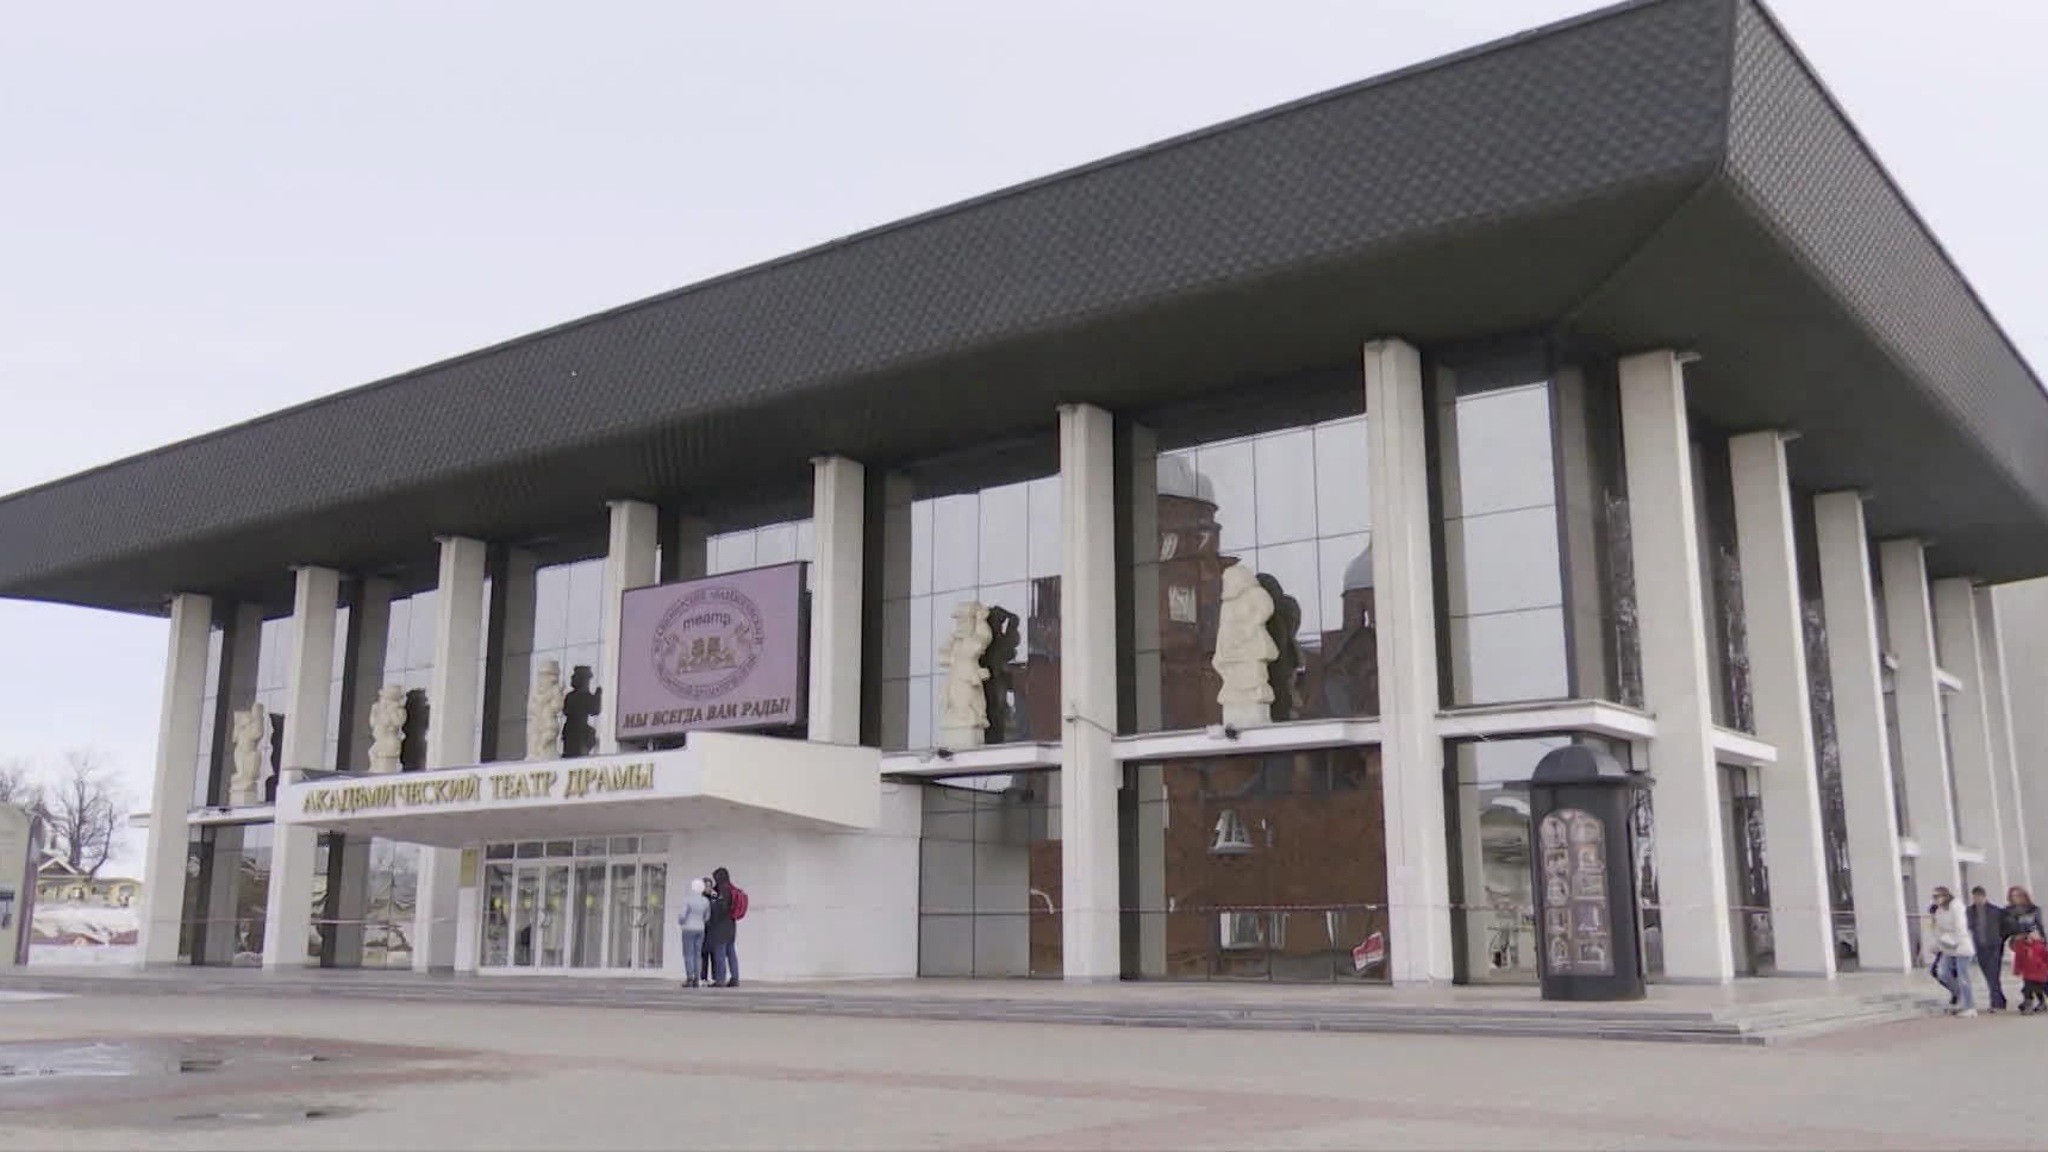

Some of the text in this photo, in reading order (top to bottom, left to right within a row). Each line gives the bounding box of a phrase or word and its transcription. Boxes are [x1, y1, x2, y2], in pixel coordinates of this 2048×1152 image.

[623, 698, 790, 729] МЫ ВСЕГДА ВАМ РАДЫ!
[303, 763, 655, 814] АКАДЕМИЧЕСКИЙ ТЕАТР ДРАМЫ
